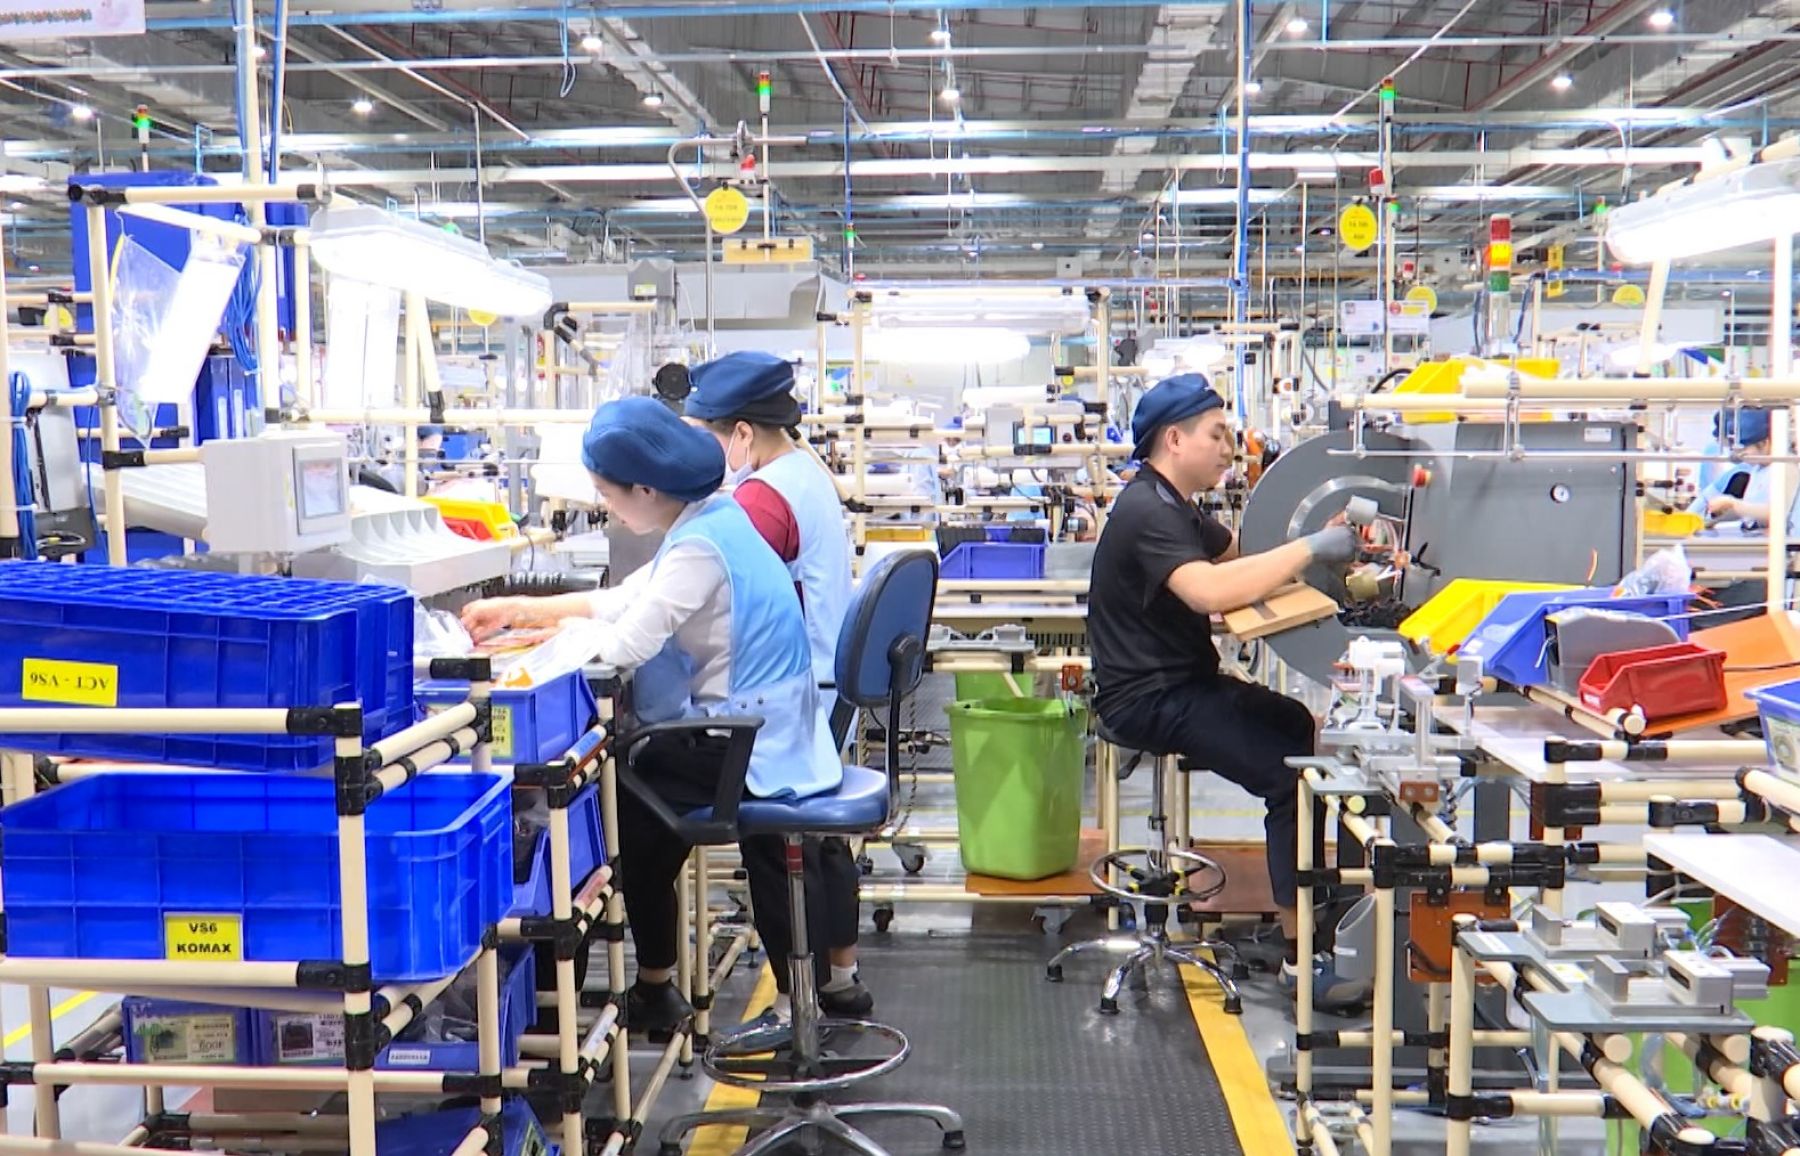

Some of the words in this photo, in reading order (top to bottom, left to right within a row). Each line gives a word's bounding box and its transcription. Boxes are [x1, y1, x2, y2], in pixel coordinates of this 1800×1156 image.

[30, 672, 59, 687] VS6
[75, 675, 109, 691] ACT
[188, 922, 218, 934] VS6
[176, 943, 231, 953] KOMAX
